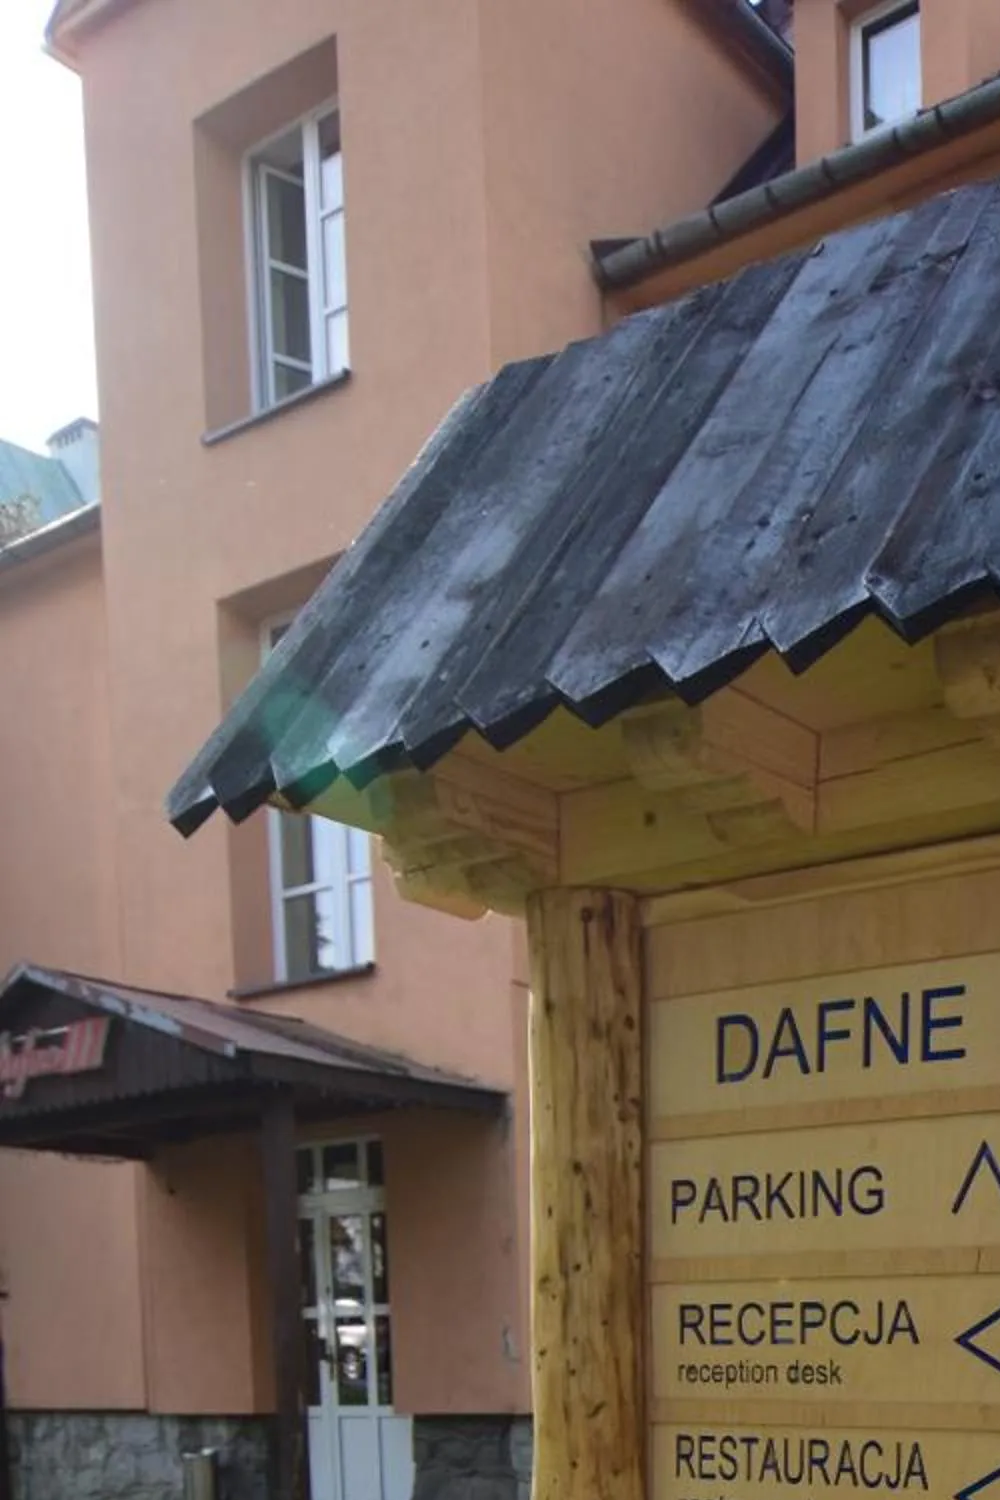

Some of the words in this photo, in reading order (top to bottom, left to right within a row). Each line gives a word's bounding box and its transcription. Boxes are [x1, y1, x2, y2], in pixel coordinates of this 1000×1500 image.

[716, 984, 967, 1085] DAFNE
[671, 1165, 885, 1225] PARKING
[679, 1299, 921, 1347] RECEPCJA
[677, 1359, 779, 1389] reception
[786, 1359, 843, 1385] desk
[675, 1434, 929, 1492] RESTAURACJA
